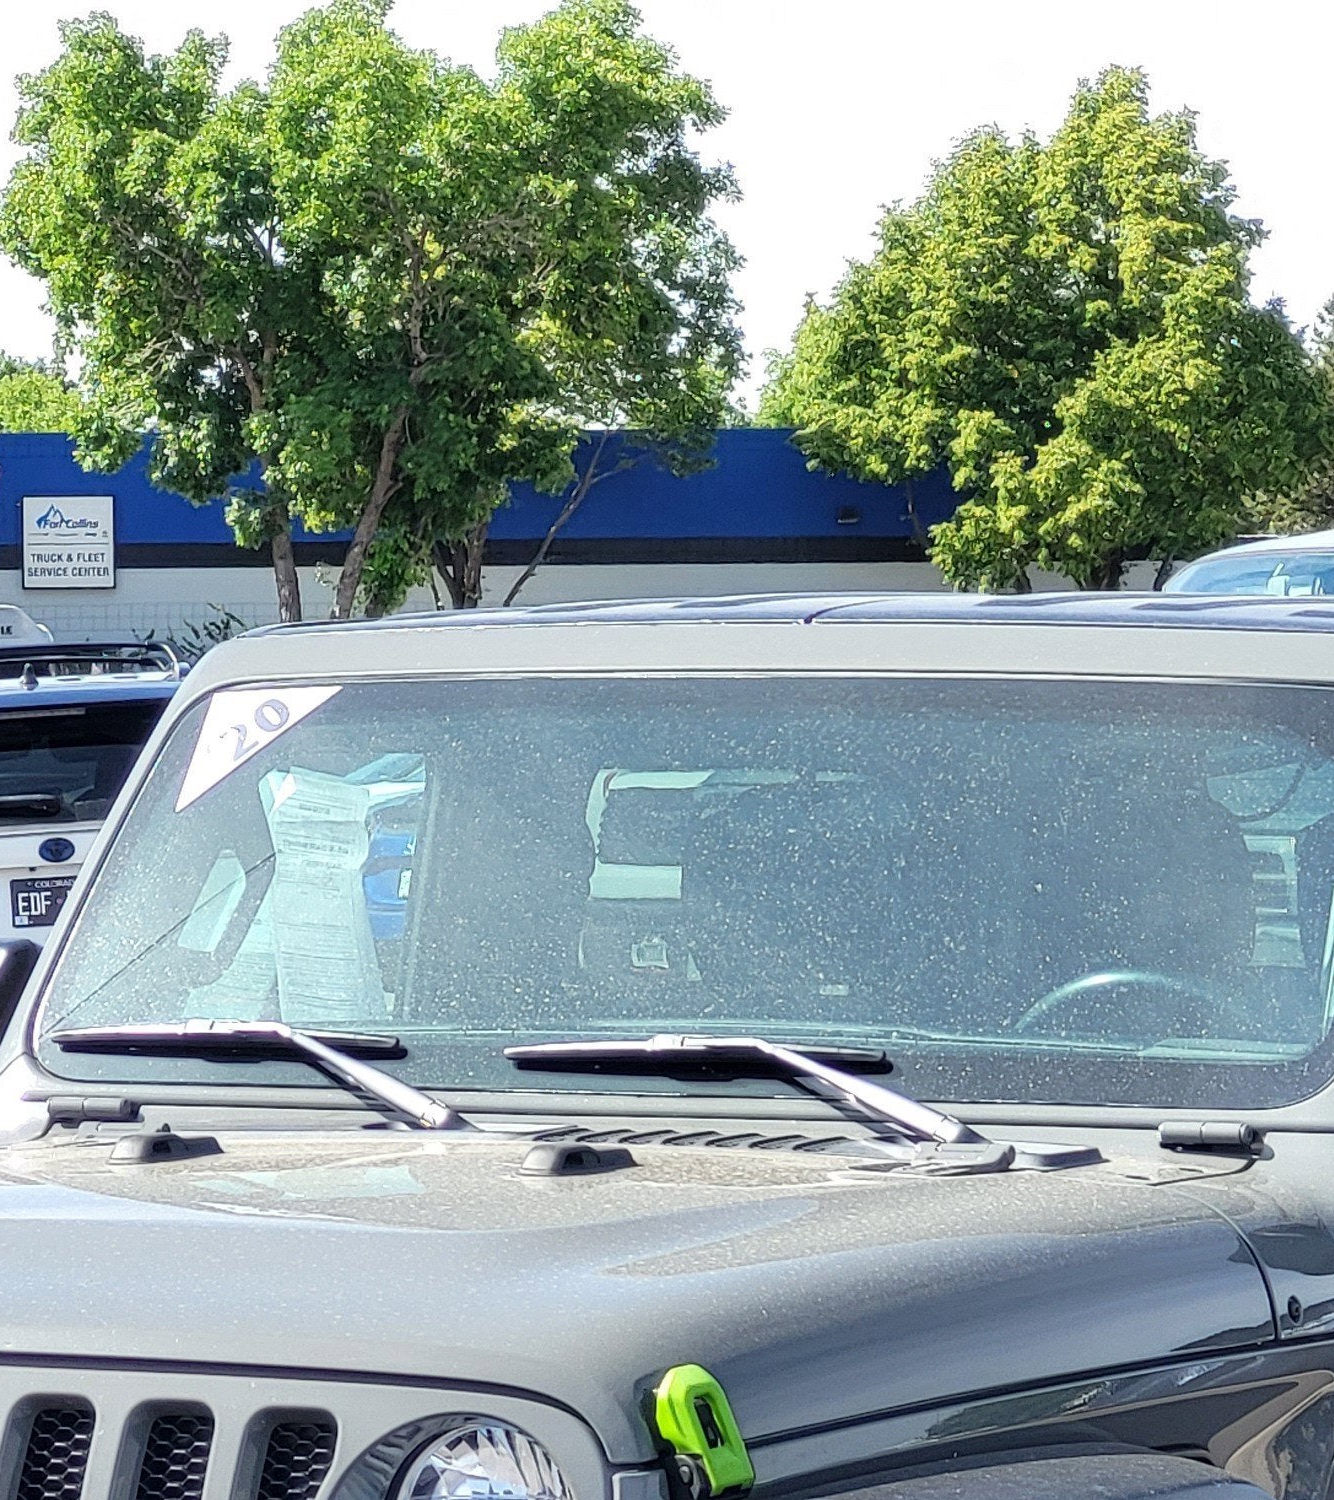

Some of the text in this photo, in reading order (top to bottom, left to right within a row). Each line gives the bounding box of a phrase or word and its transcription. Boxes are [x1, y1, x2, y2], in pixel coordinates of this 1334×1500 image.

[66, 518, 99, 529] Collins
[30, 552, 106, 563] TRUCK & FLEET
[27, 566, 110, 577] SERVICE CENTER
[17, 891, 52, 916] EDF
